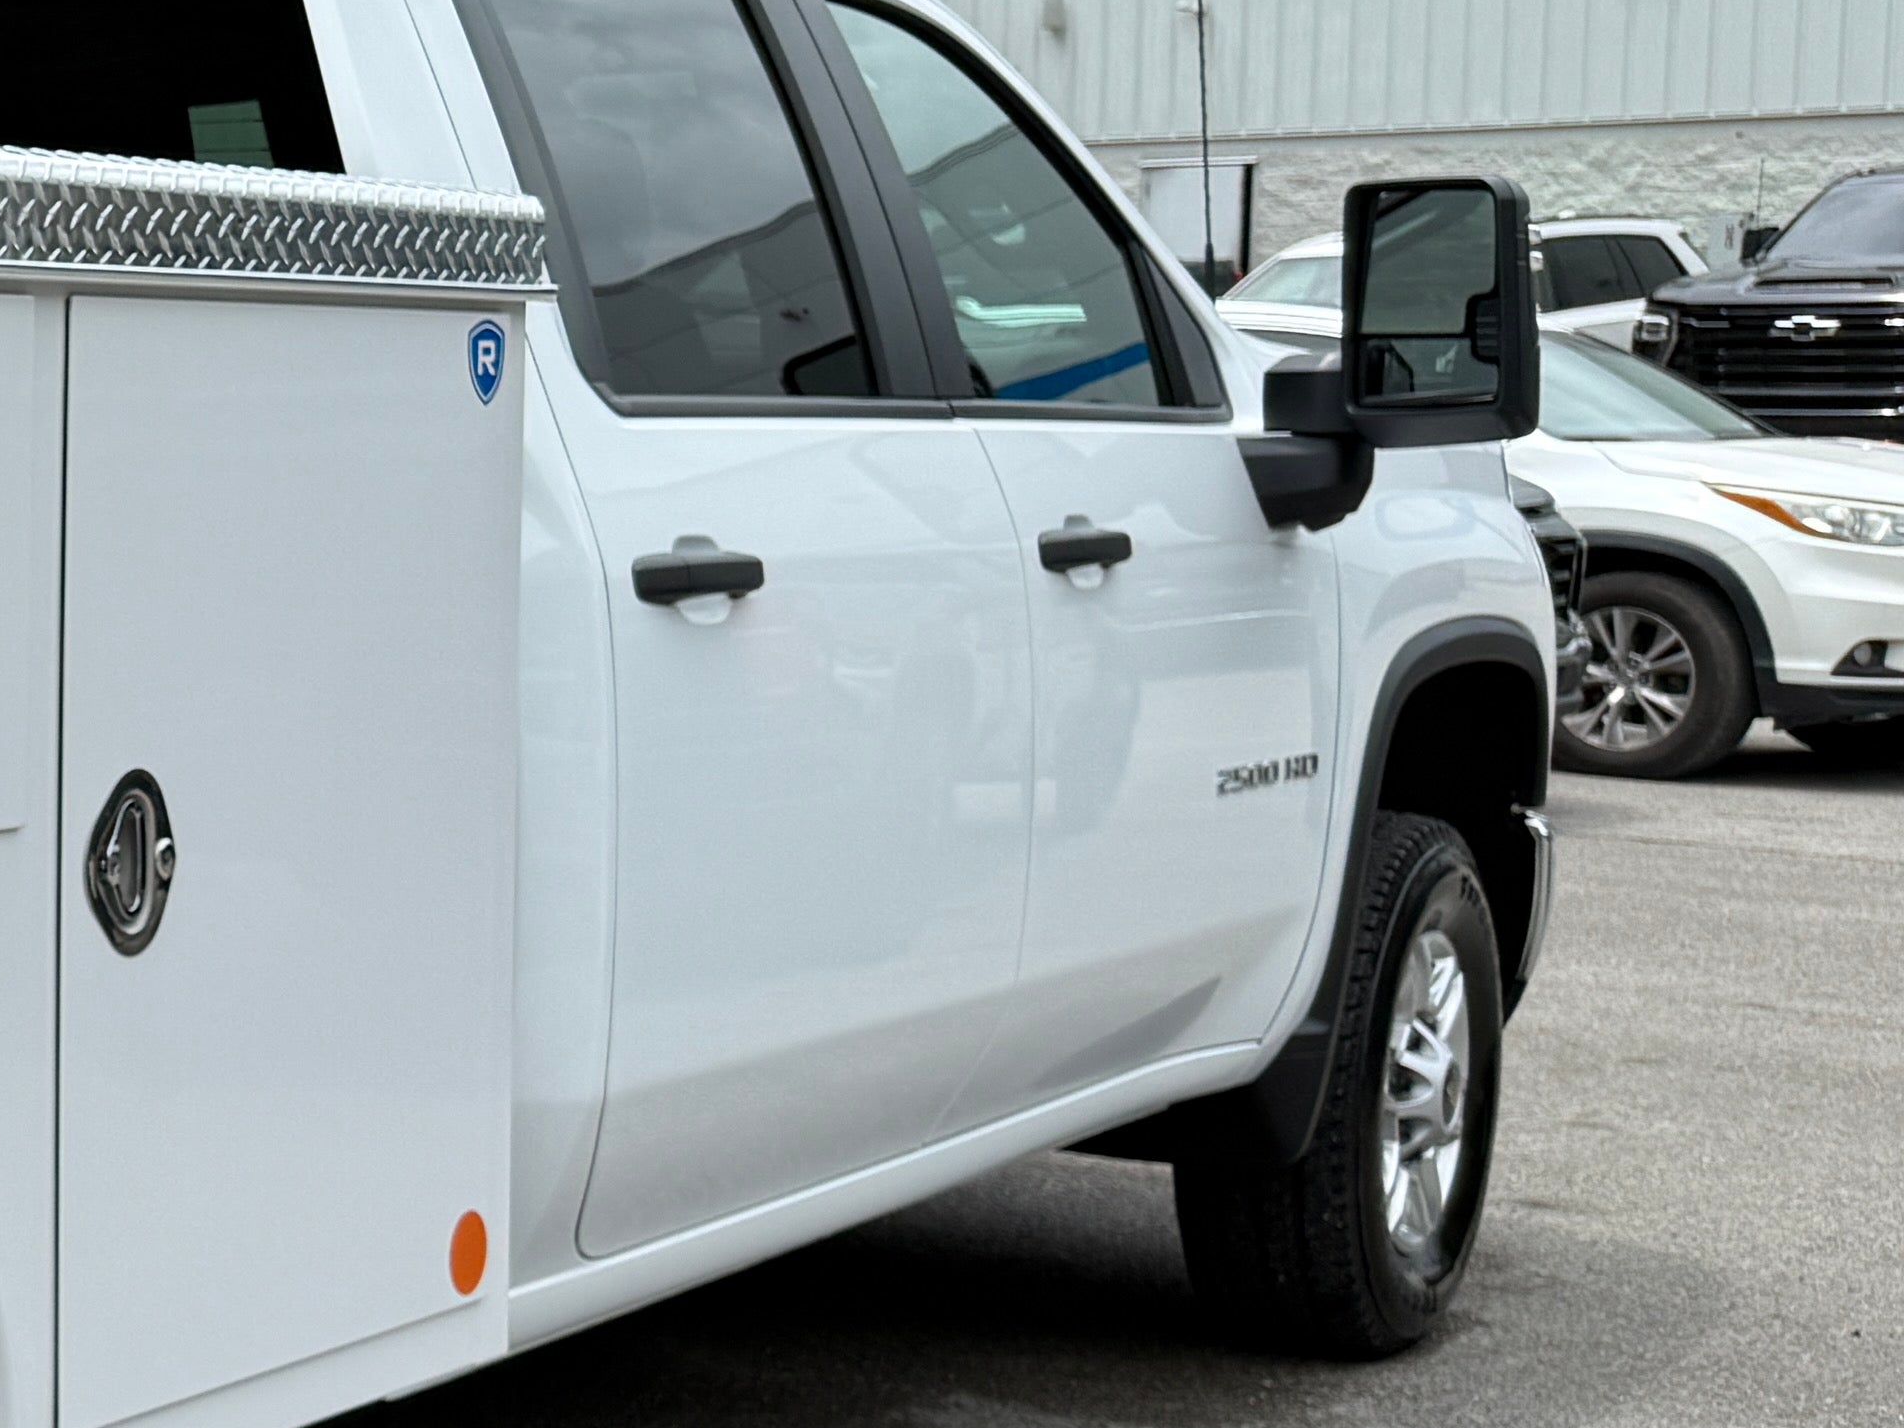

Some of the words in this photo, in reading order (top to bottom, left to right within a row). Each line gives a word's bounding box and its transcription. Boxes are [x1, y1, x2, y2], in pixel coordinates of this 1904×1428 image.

[478, 340, 496, 376] R
[1217, 760, 1279, 795] 2500
[1284, 753, 1319, 781] HD
